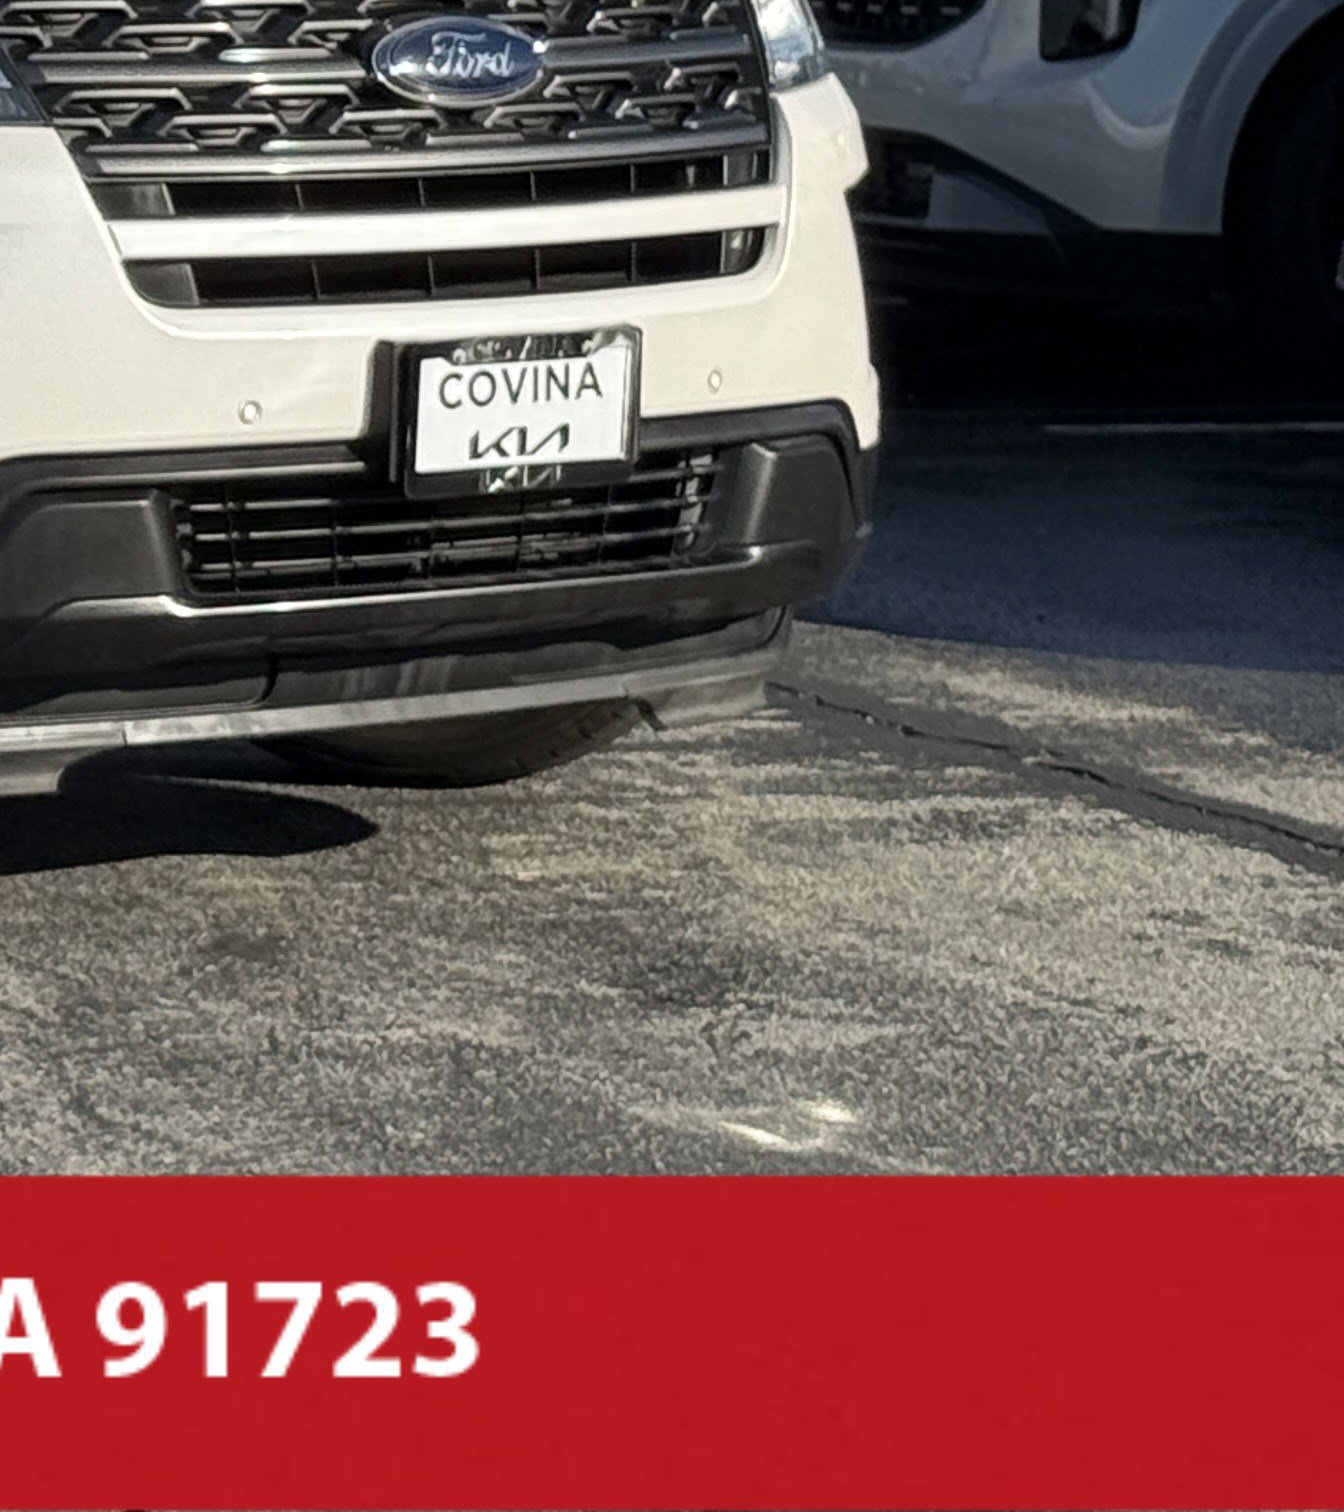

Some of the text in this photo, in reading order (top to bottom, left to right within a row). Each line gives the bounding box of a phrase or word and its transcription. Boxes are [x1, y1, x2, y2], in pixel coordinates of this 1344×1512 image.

[425, 31, 516, 78] Ford
[439, 362, 602, 408] COVINA
[469, 423, 570, 460] KIA
